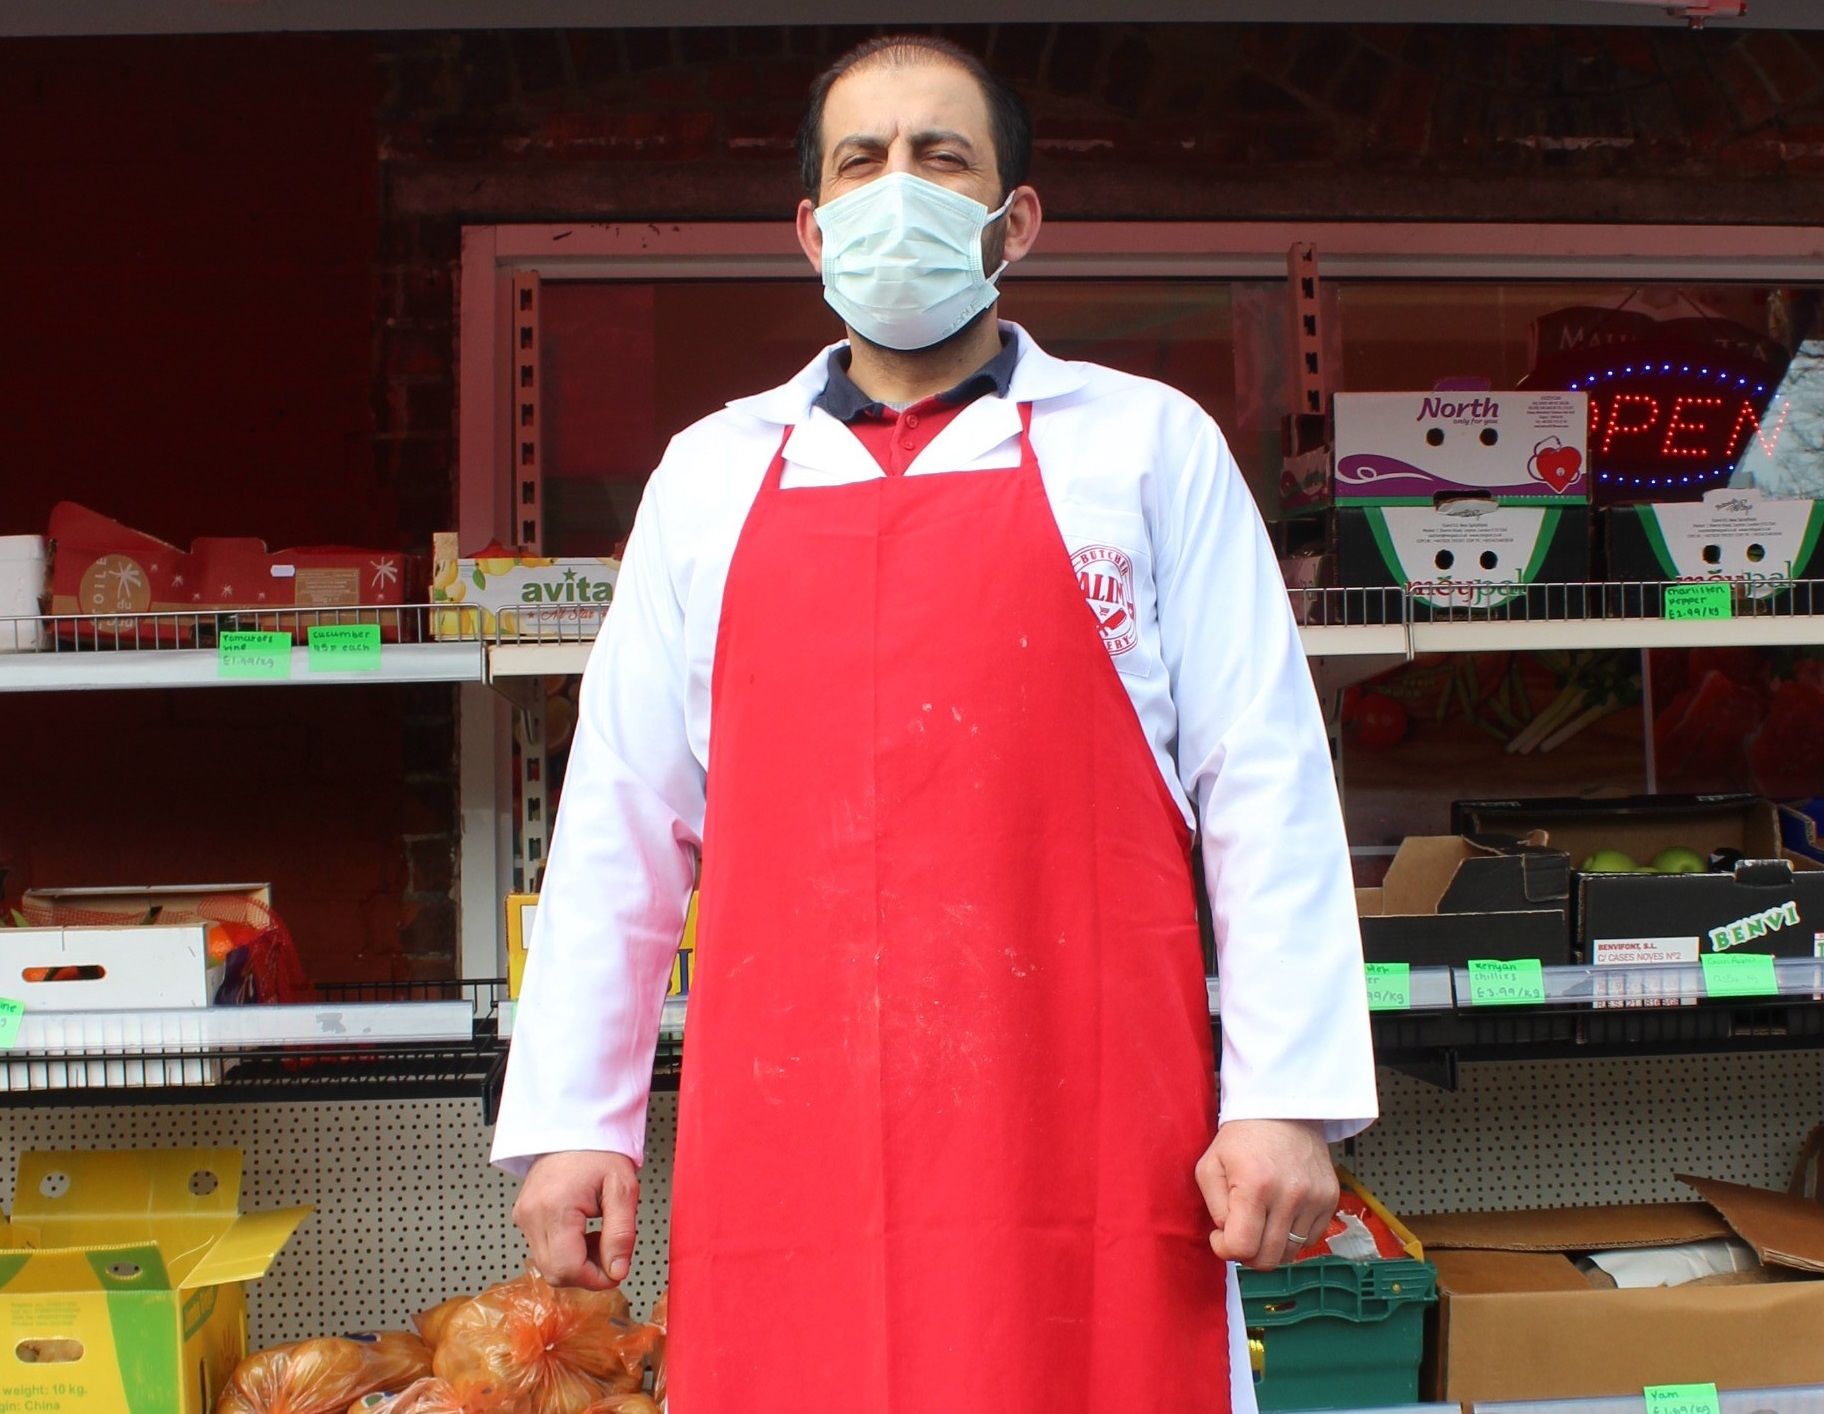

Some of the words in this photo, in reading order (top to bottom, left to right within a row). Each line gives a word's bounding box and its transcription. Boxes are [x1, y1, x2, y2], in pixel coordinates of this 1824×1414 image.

[1417, 398, 1499, 421] North
[1453, 418, 1469, 426] only
[1471, 418, 1482, 426] for
[521, 567, 613, 602] avita
[1711, 902, 1799, 950] BENVI
[1608, 953, 1634, 962] CASES
[1637, 952, 1664, 961] NOVES
[54, 1384, 65, 1394] 10
[24, 1400, 60, 1410] China
